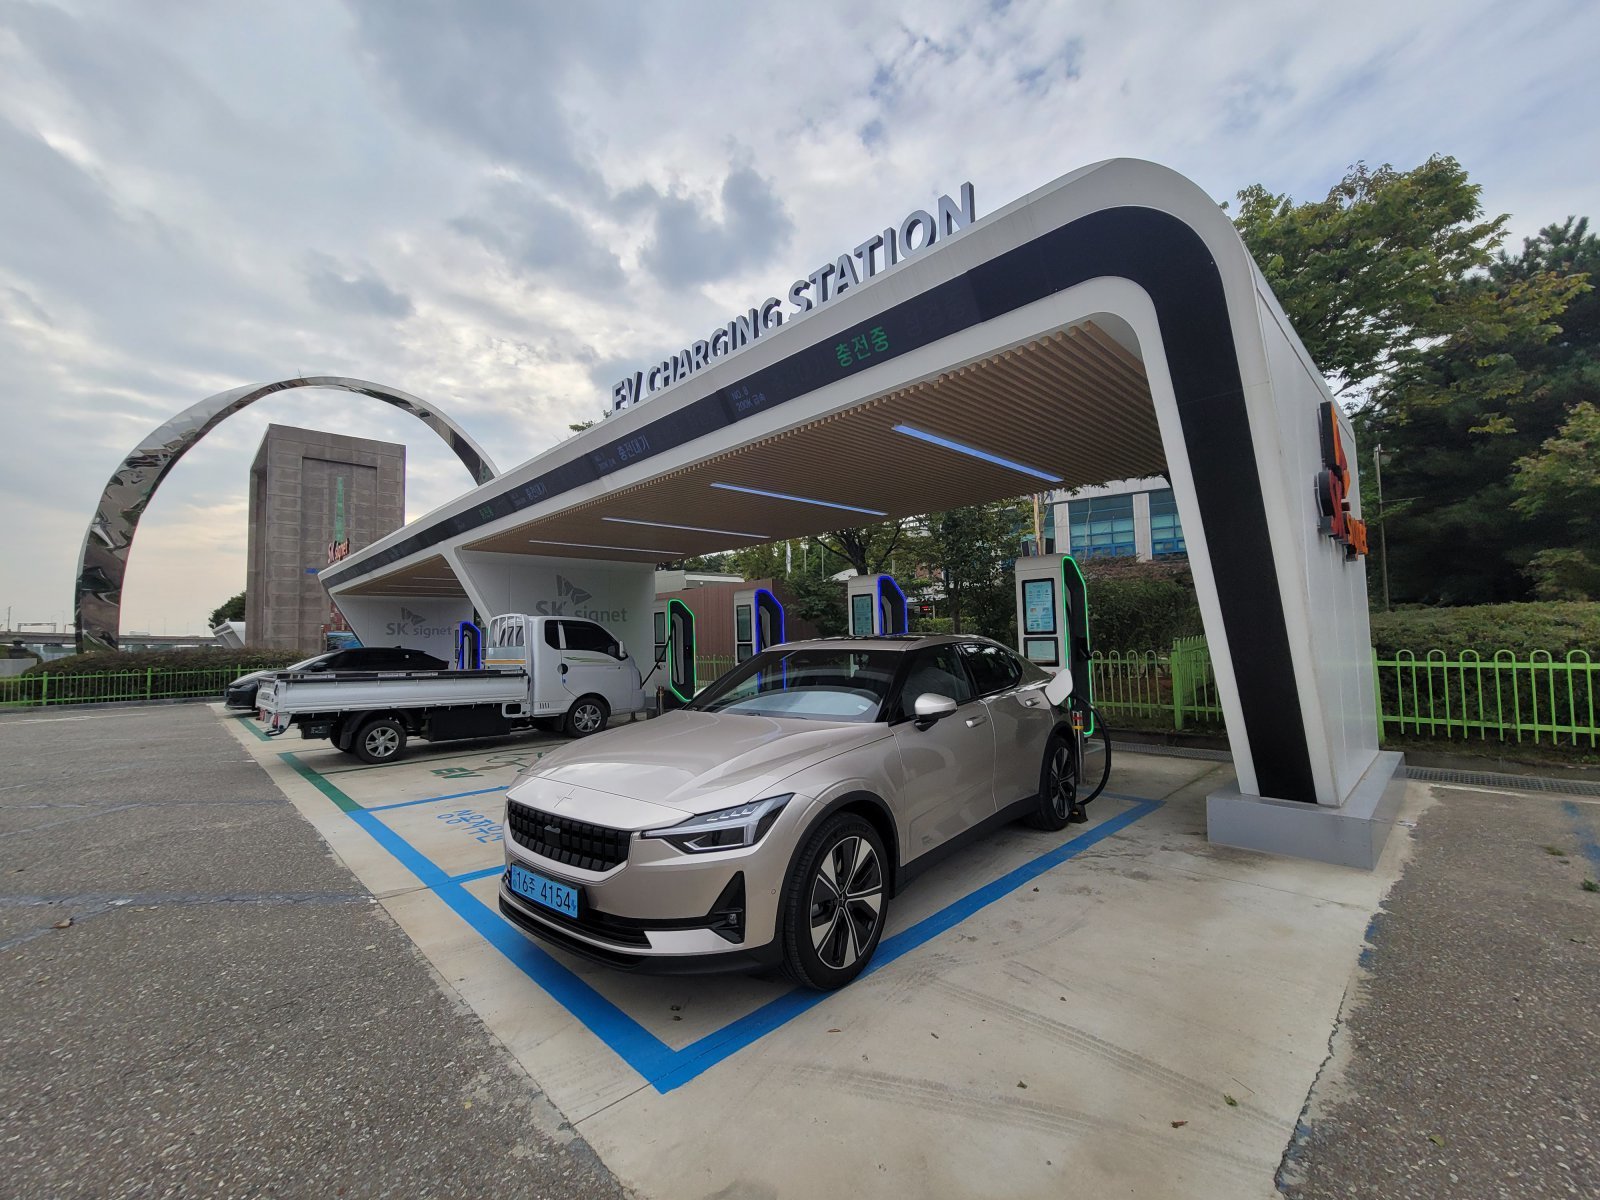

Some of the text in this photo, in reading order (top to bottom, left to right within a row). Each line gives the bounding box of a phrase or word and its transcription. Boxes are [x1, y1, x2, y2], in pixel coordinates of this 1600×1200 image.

[611, 181, 975, 413] EV CHARGING STATION
[834, 326, 890, 368] 충전중
[616, 434, 651, 461] 충전대기
[535, 600, 628, 622] SK signet
[385, 622, 453, 639] SK signet
[517, 871, 571, 911] 16주 4154
